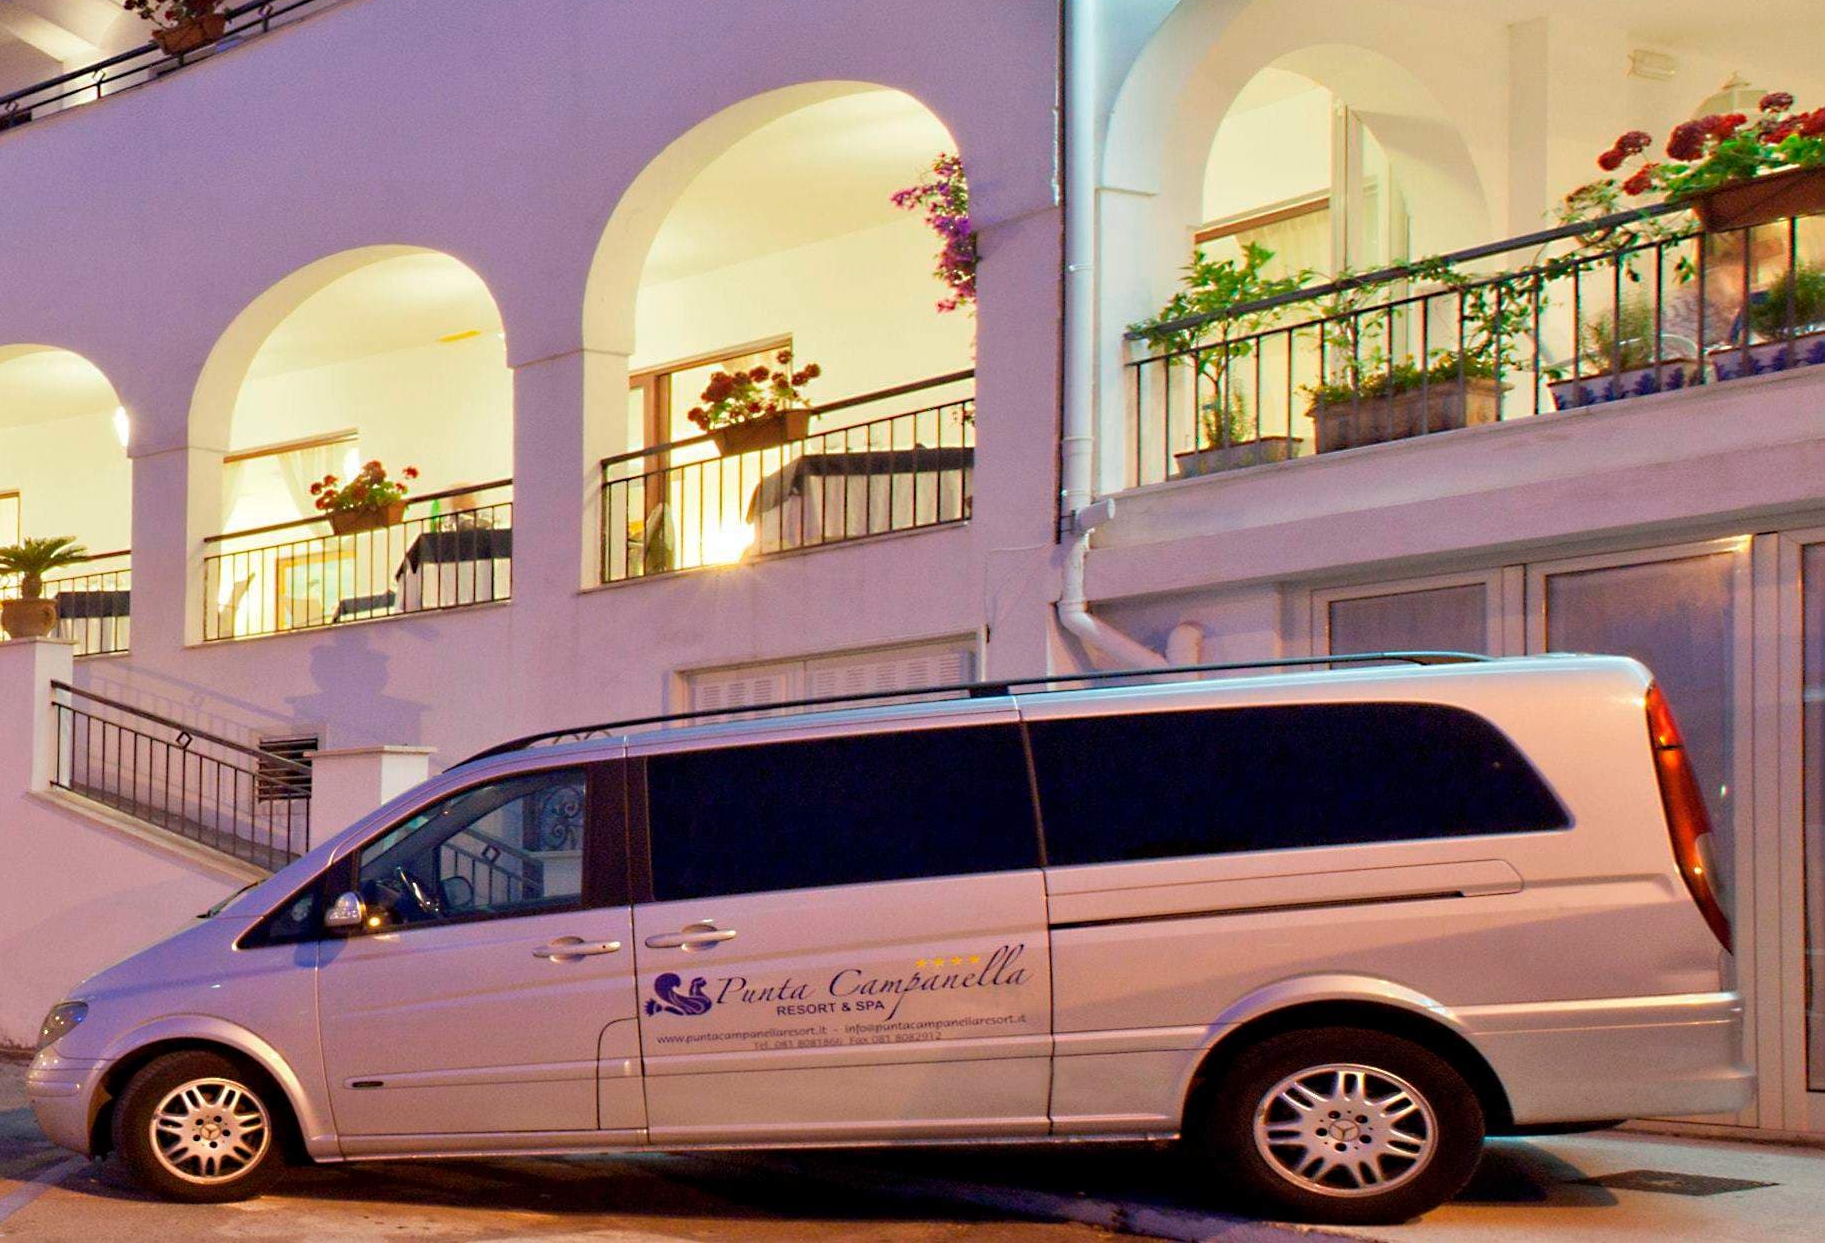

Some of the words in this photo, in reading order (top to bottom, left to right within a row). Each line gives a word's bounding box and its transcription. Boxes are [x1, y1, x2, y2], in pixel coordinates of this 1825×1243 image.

[717, 976, 812, 1005] Punta
[829, 944, 1029, 1021] Campanella
[777, 1002, 838, 1017] RESORT
[842, 1002, 853, 1014] &
[856, 999, 886, 1013] SPA
[656, 1025, 828, 1045] www.puntacampanellaresort.it
[845, 1014, 1026, 1034] info@puntacampanellaresort.it
